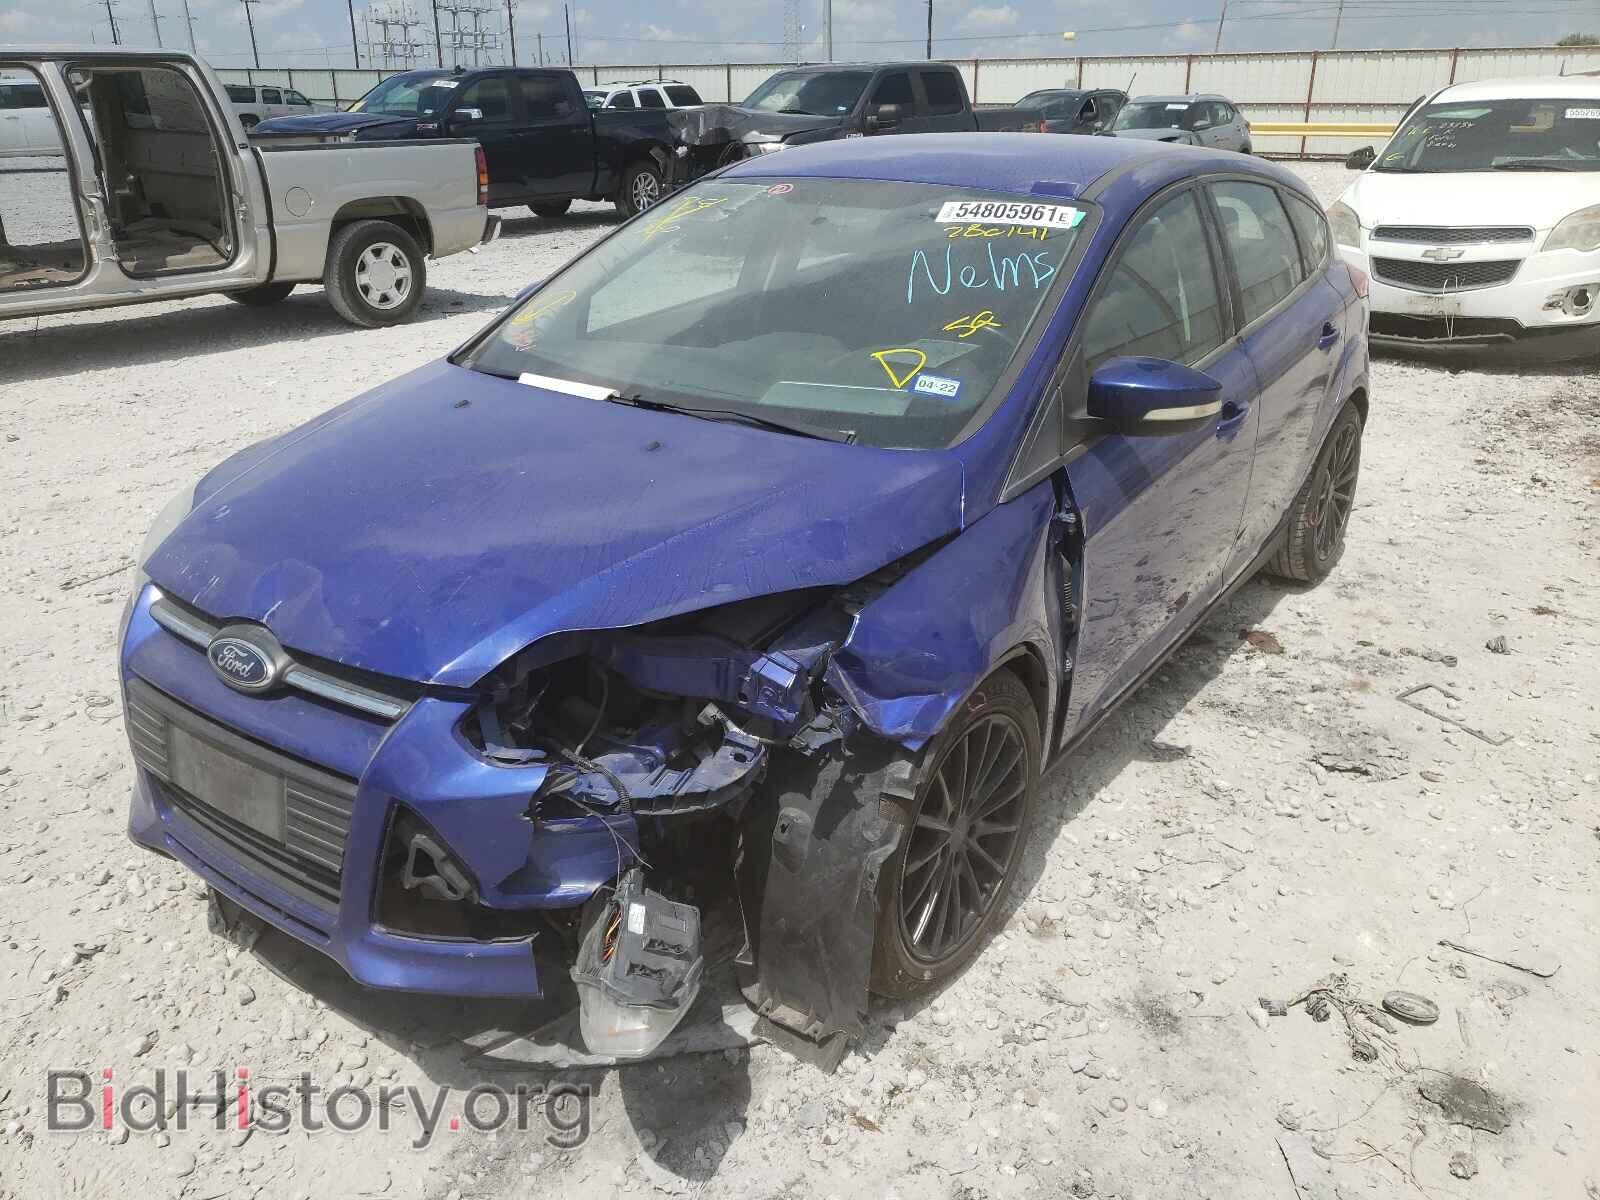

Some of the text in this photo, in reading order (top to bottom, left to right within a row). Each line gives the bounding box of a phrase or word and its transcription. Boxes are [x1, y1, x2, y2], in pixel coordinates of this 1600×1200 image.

[955, 202, 1058, 222] 54805961
[908, 242, 1056, 304] Nelms
[917, 378, 957, 394] 04-22
[217, 645, 256, 678] Ford
